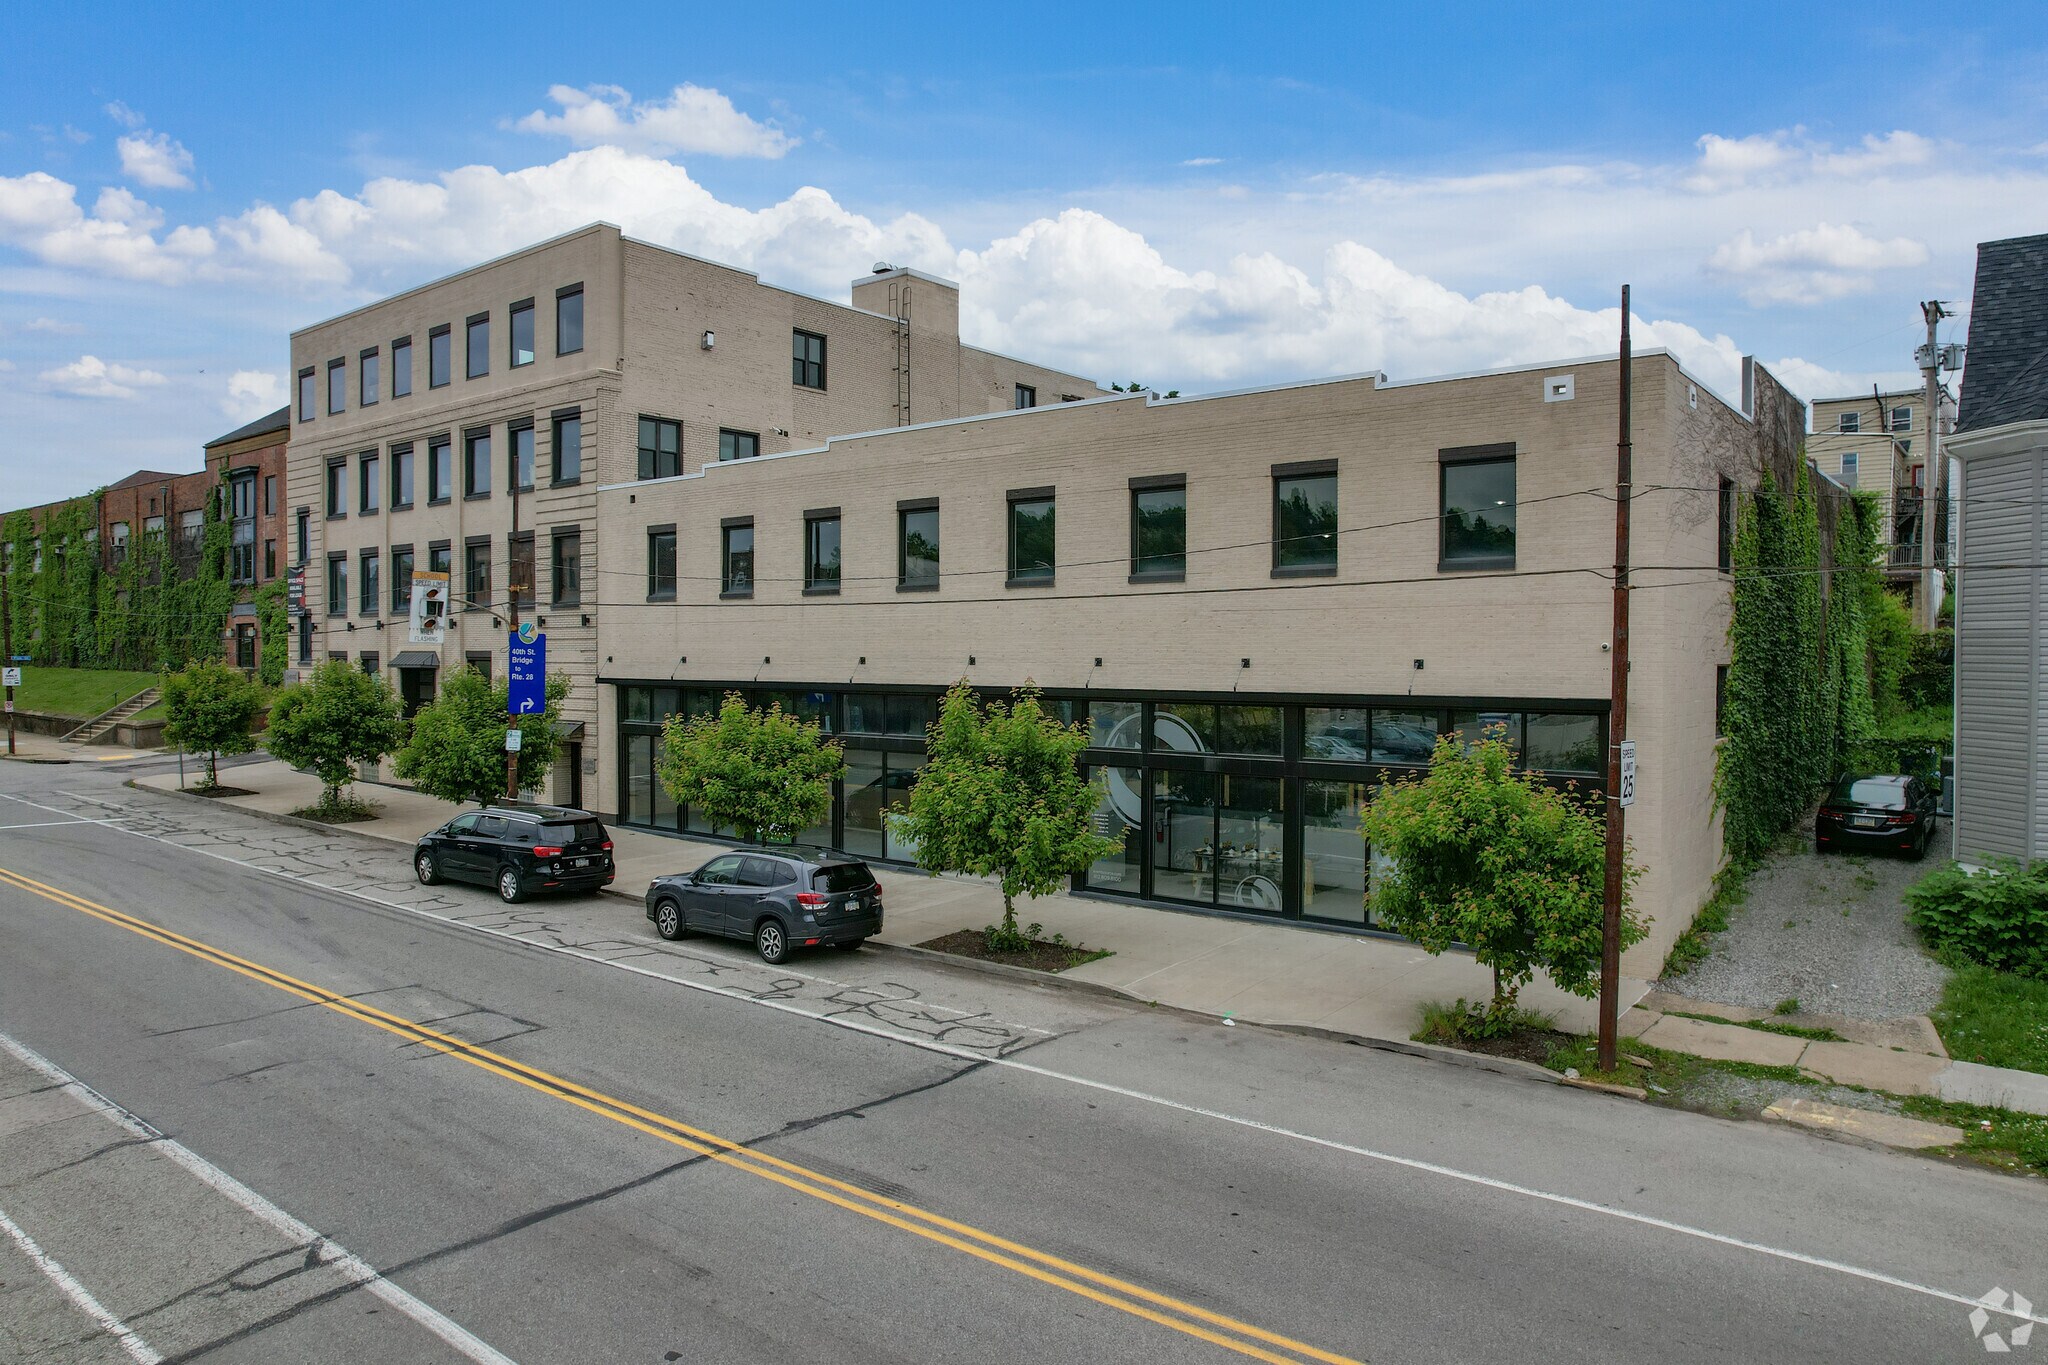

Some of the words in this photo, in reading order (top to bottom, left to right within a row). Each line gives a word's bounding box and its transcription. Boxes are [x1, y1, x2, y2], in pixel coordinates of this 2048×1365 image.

[432, 580, 446, 588] LIMIT
[511, 648, 526, 656] 40th
[527, 648, 536, 656] St.
[511, 656, 534, 666] Bridge
[511, 673, 525, 681] Rte.
[525, 673, 534, 681] 28
[1622, 748, 1635, 760] SPEED
[1623, 761, 1634, 773] LIMIT
[1622, 774, 1634, 799] 25
